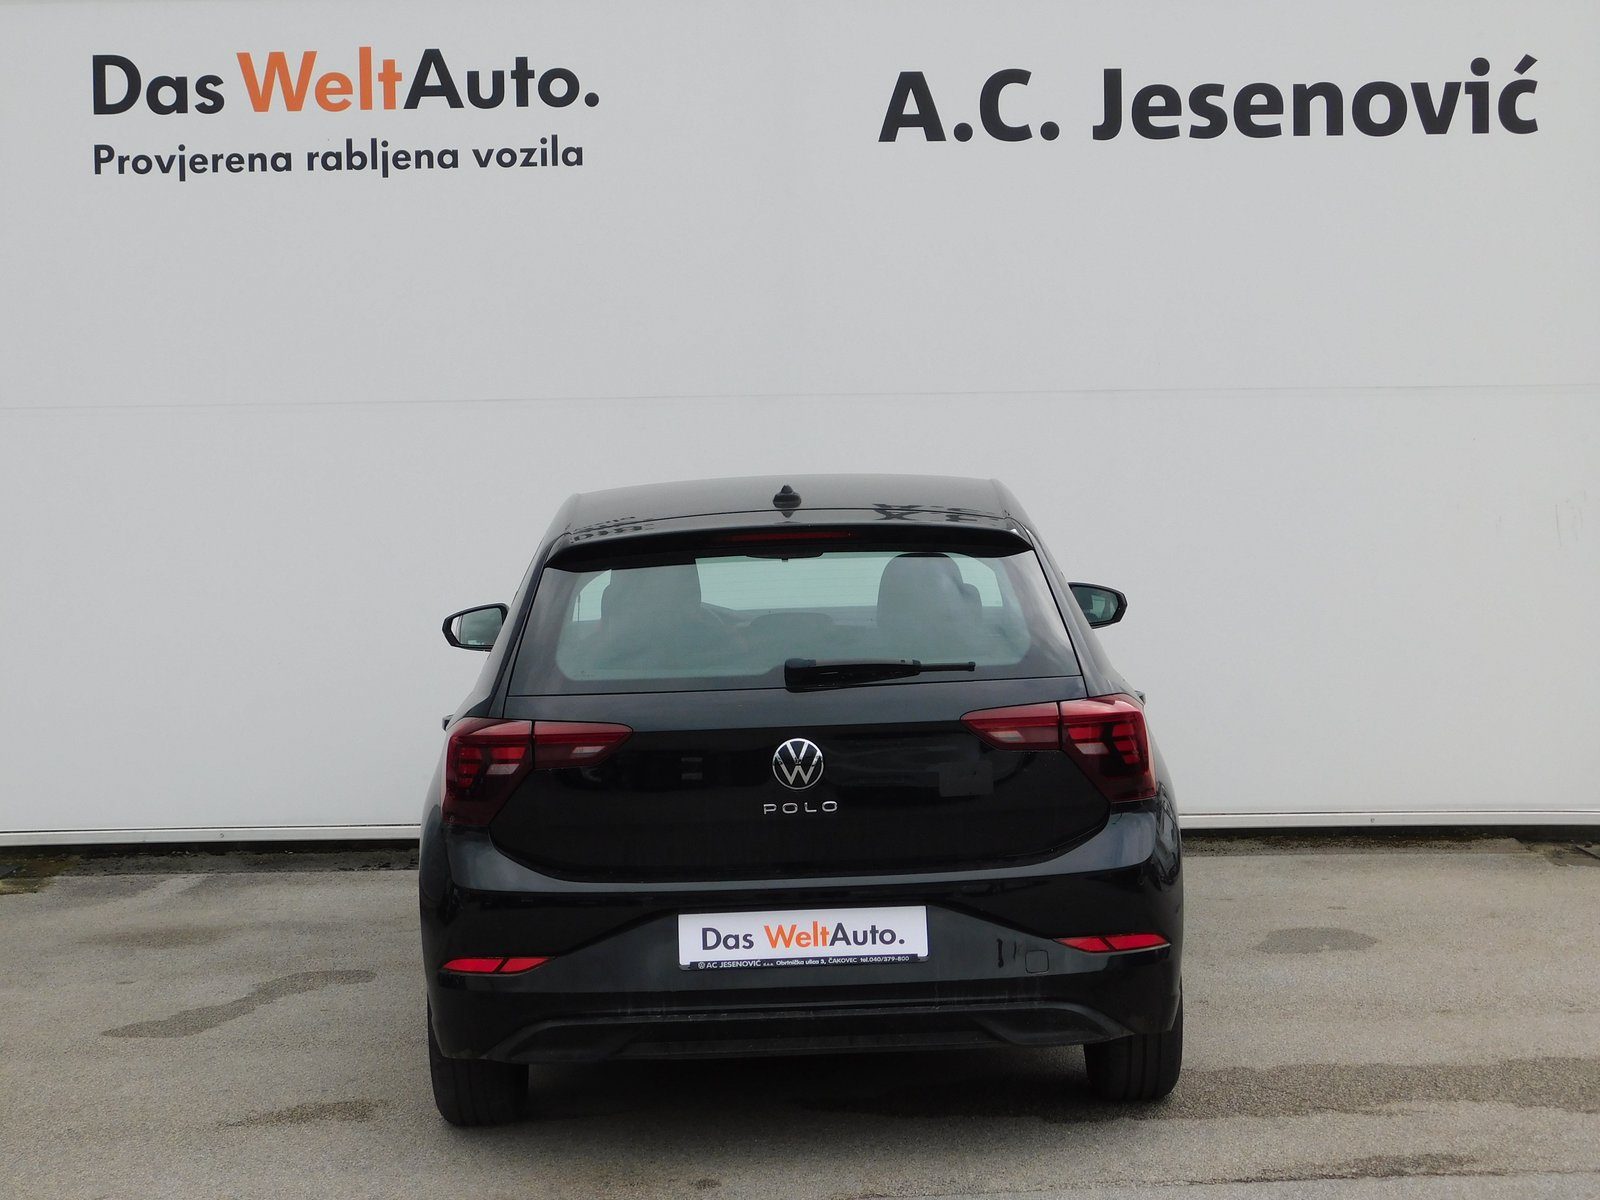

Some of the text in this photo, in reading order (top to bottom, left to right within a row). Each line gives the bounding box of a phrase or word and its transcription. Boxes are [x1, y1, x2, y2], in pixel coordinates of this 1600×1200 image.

[92, 46, 600, 115] Das WeltAuto.
[877, 53, 1539, 143] A.C. Jesenović
[93, 134, 584, 182] Provjerena rabljena vozila
[763, 800, 838, 815] POLO
[701, 920, 905, 951] Das WeltAuto.
[706, 961, 718, 969] AC
[719, 959, 762, 968] JESENOVIĆ
[828, 956, 858, 965] ČAKOVEC
